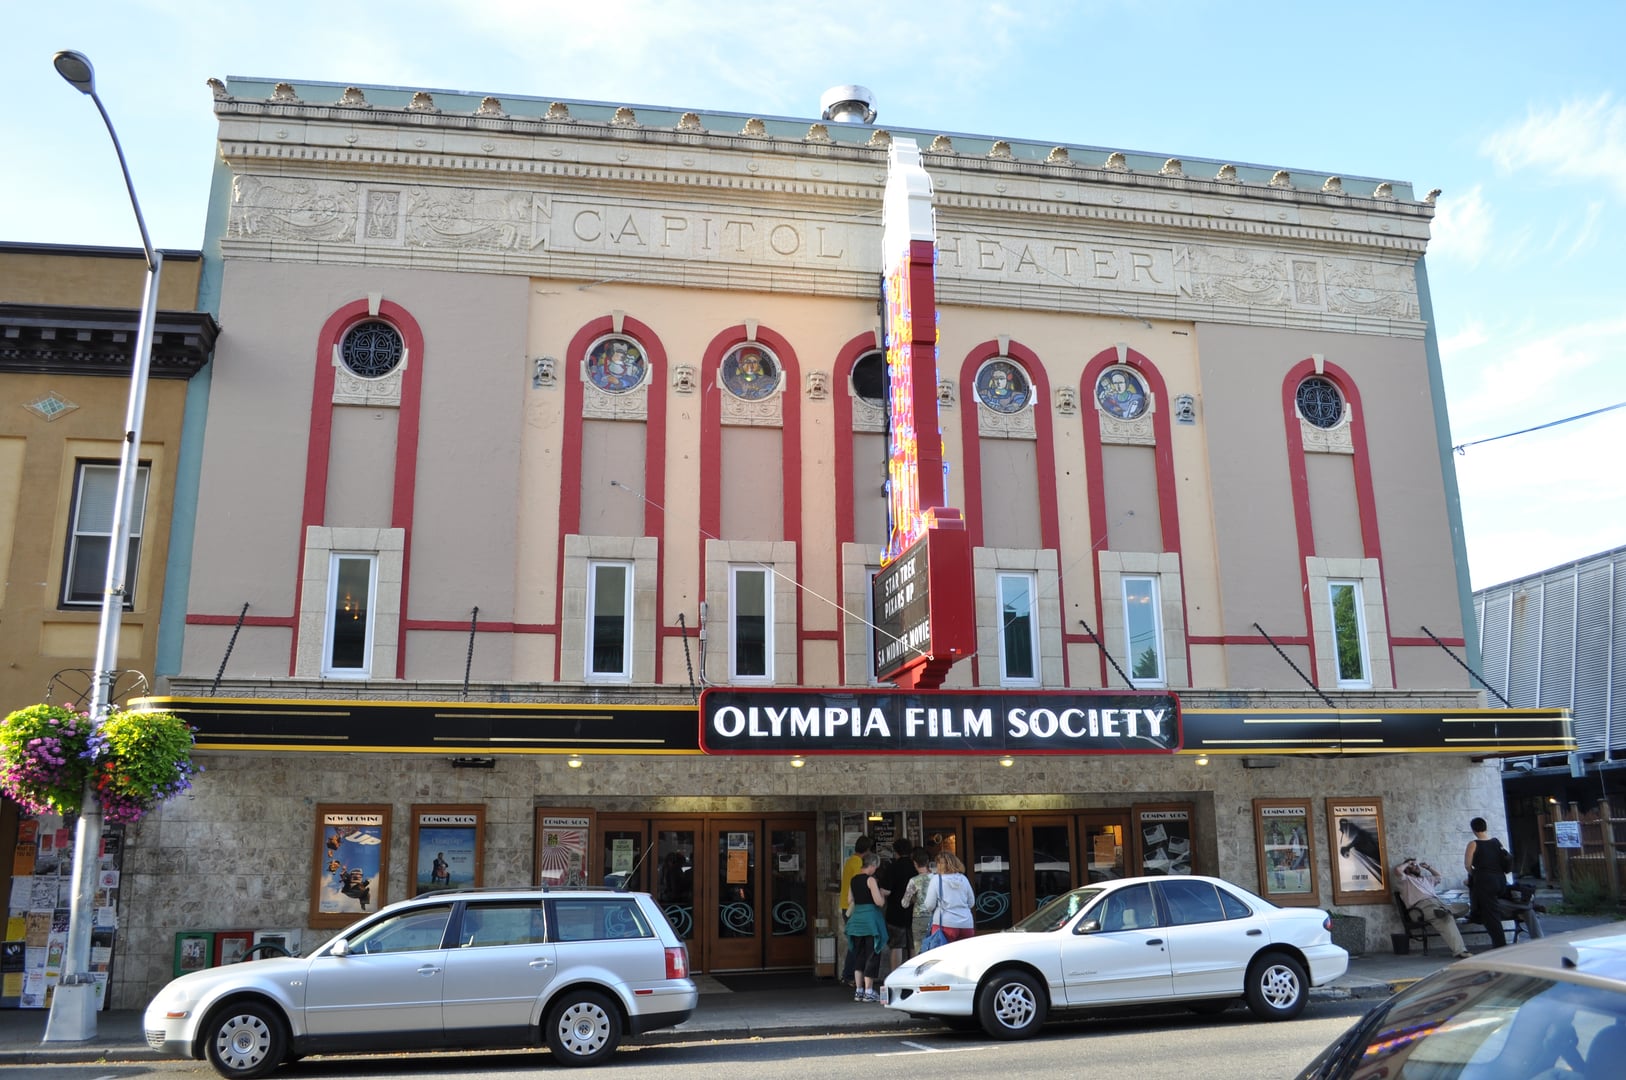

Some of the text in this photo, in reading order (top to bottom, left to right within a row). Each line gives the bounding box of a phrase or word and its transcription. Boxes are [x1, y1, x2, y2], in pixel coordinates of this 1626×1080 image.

[572, 210, 843, 259] CAPITOL
[935, 236, 1164, 284] HEATER
[885, 557, 916, 596] STAR TREK
[884, 582, 915, 619] PIXARS UP
[909, 619, 930, 646] MOVIE
[712, 705, 1165, 738] OLYMPIA FILM SOCIETY
[345, 830, 382, 846] UP
